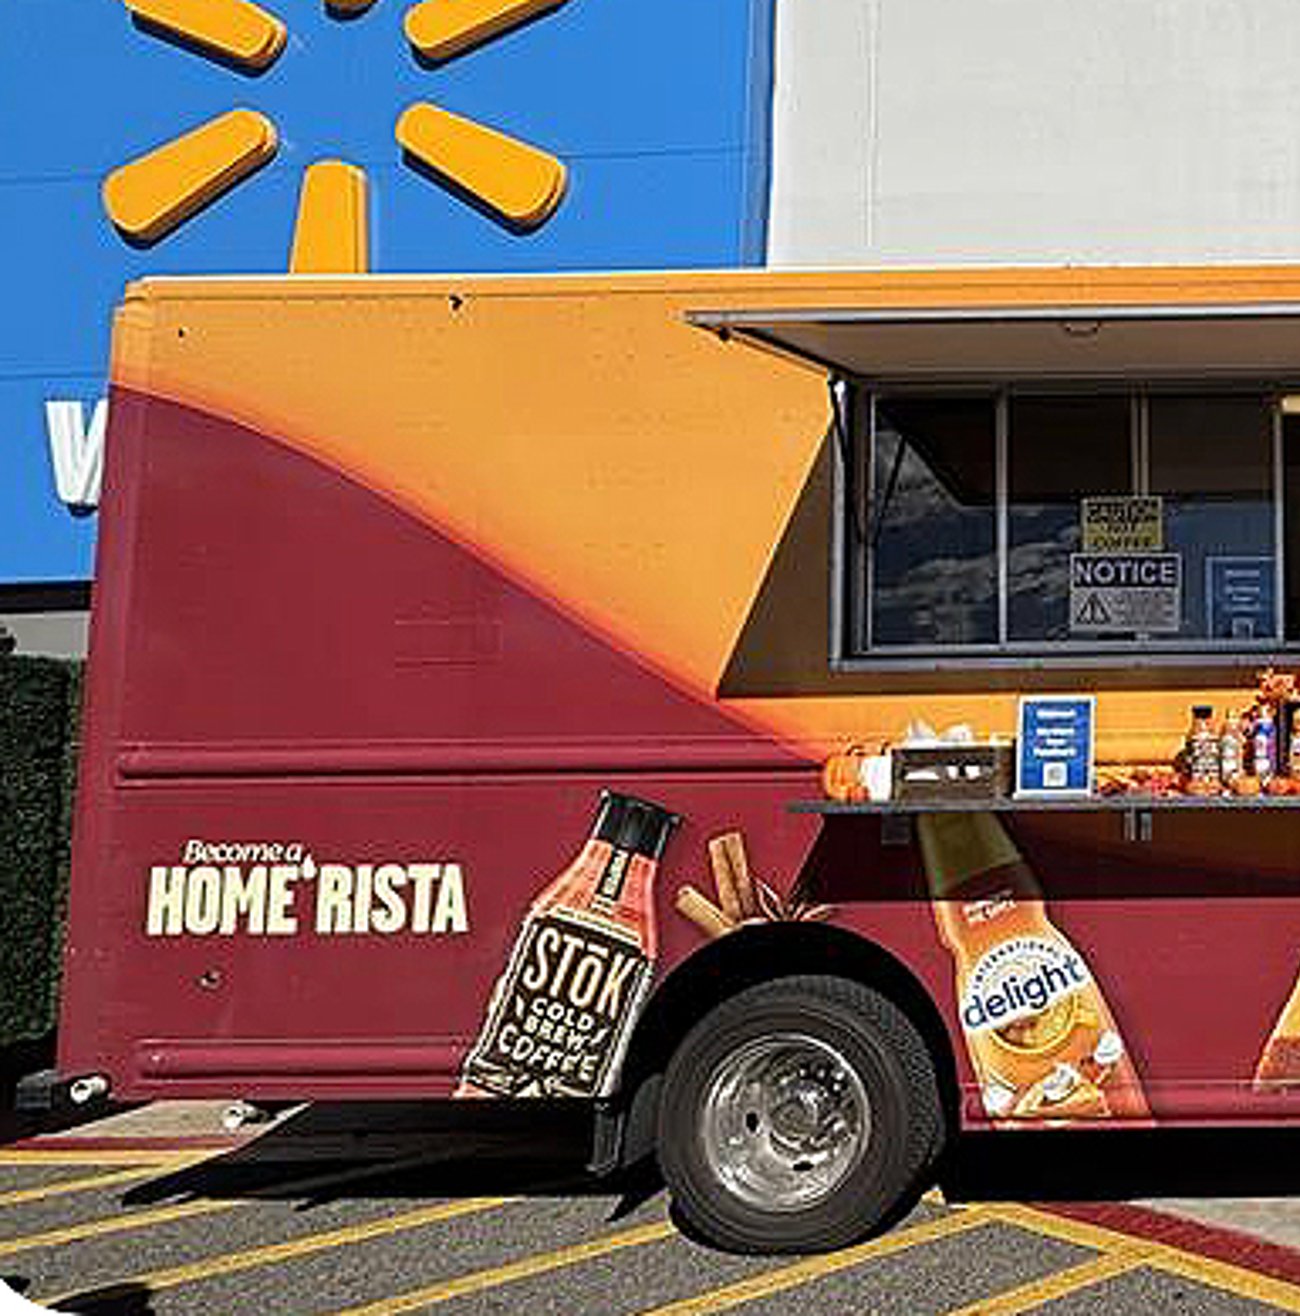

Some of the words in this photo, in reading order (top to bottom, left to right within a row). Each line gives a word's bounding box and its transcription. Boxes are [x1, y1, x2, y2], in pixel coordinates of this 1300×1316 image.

[1074, 560, 1176, 586] NOTICE
[183, 839, 283, 863] Become
[285, 843, 301, 862] a
[964, 964, 1085, 1028] delight
[530, 997, 595, 1032] COLD
[523, 1016, 590, 1052] BREW
[497, 1024, 599, 1082] COFFEE
